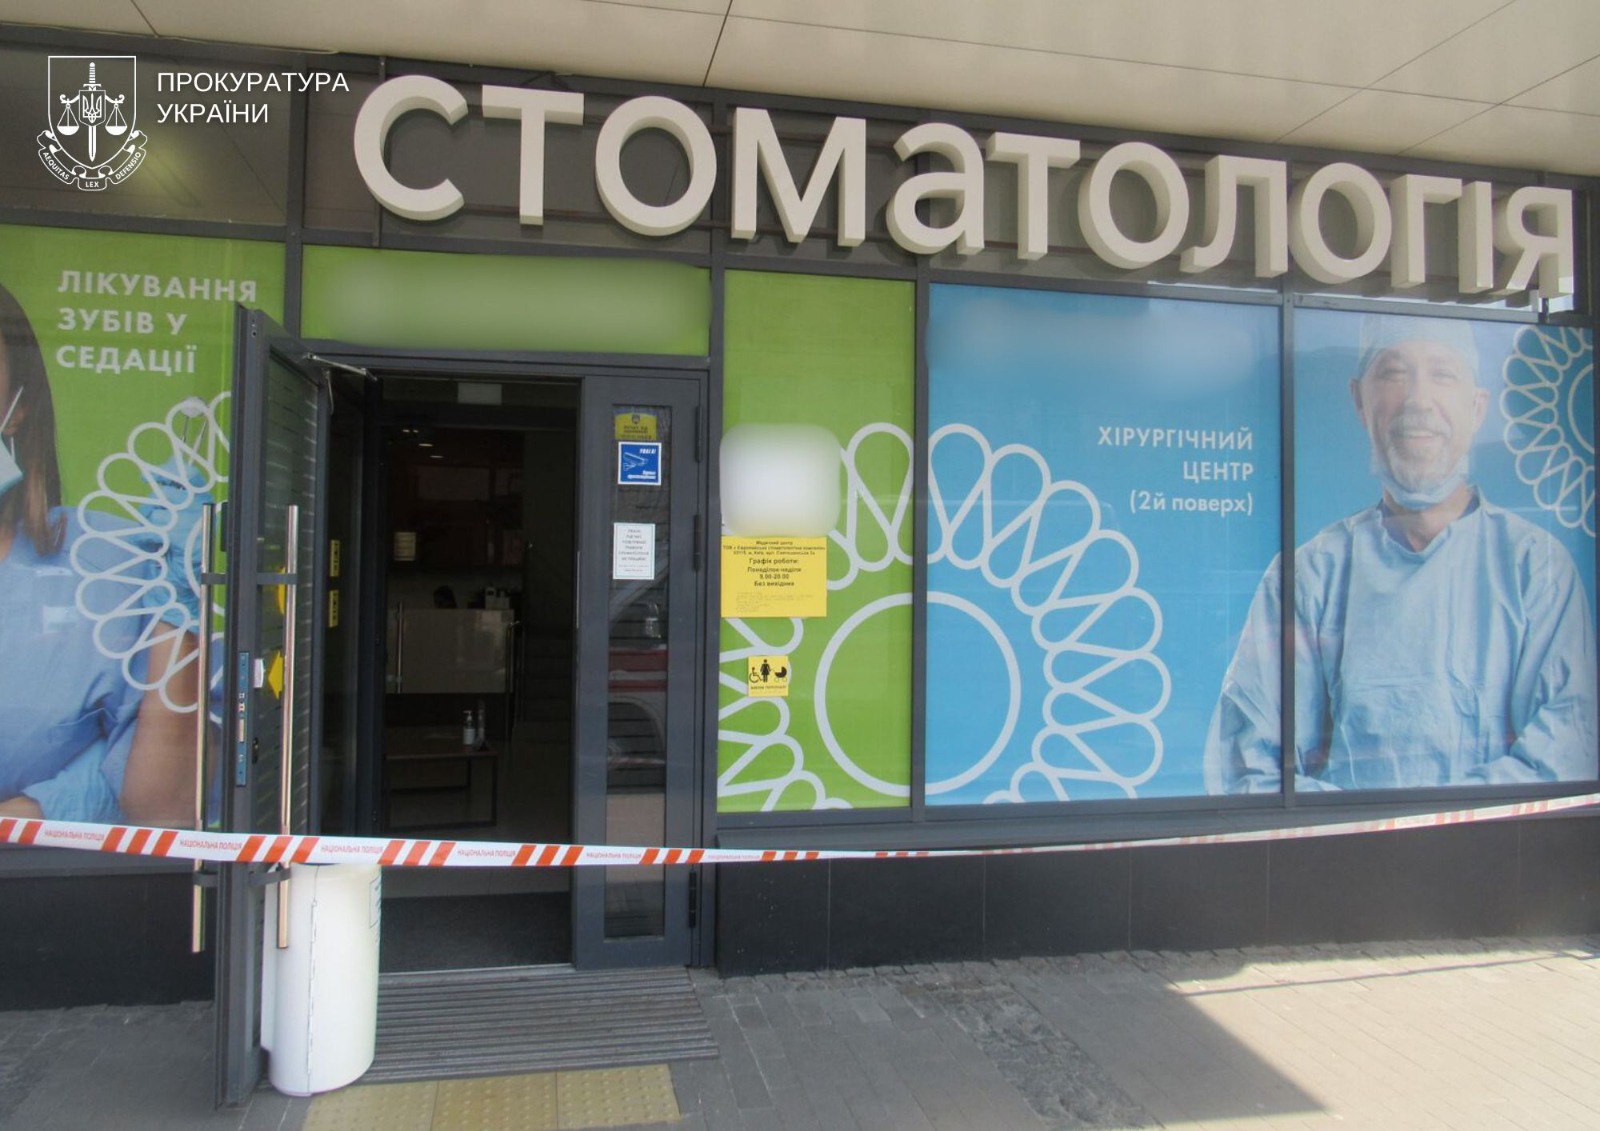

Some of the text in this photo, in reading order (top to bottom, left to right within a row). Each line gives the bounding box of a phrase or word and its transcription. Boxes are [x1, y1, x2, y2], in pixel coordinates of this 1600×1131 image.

[57, 270, 257, 303] ЛІКУВАННЯ
[57, 307, 187, 335] ЗУБІВ У
[56, 345, 197, 376] СЕДАЦІЇ
[1098, 426, 1253, 450] ХІРУРГІЧНИЙ
[1183, 461, 1254, 483] ЦЕНТР
[1130, 489, 1253, 517] (2й поверх)
